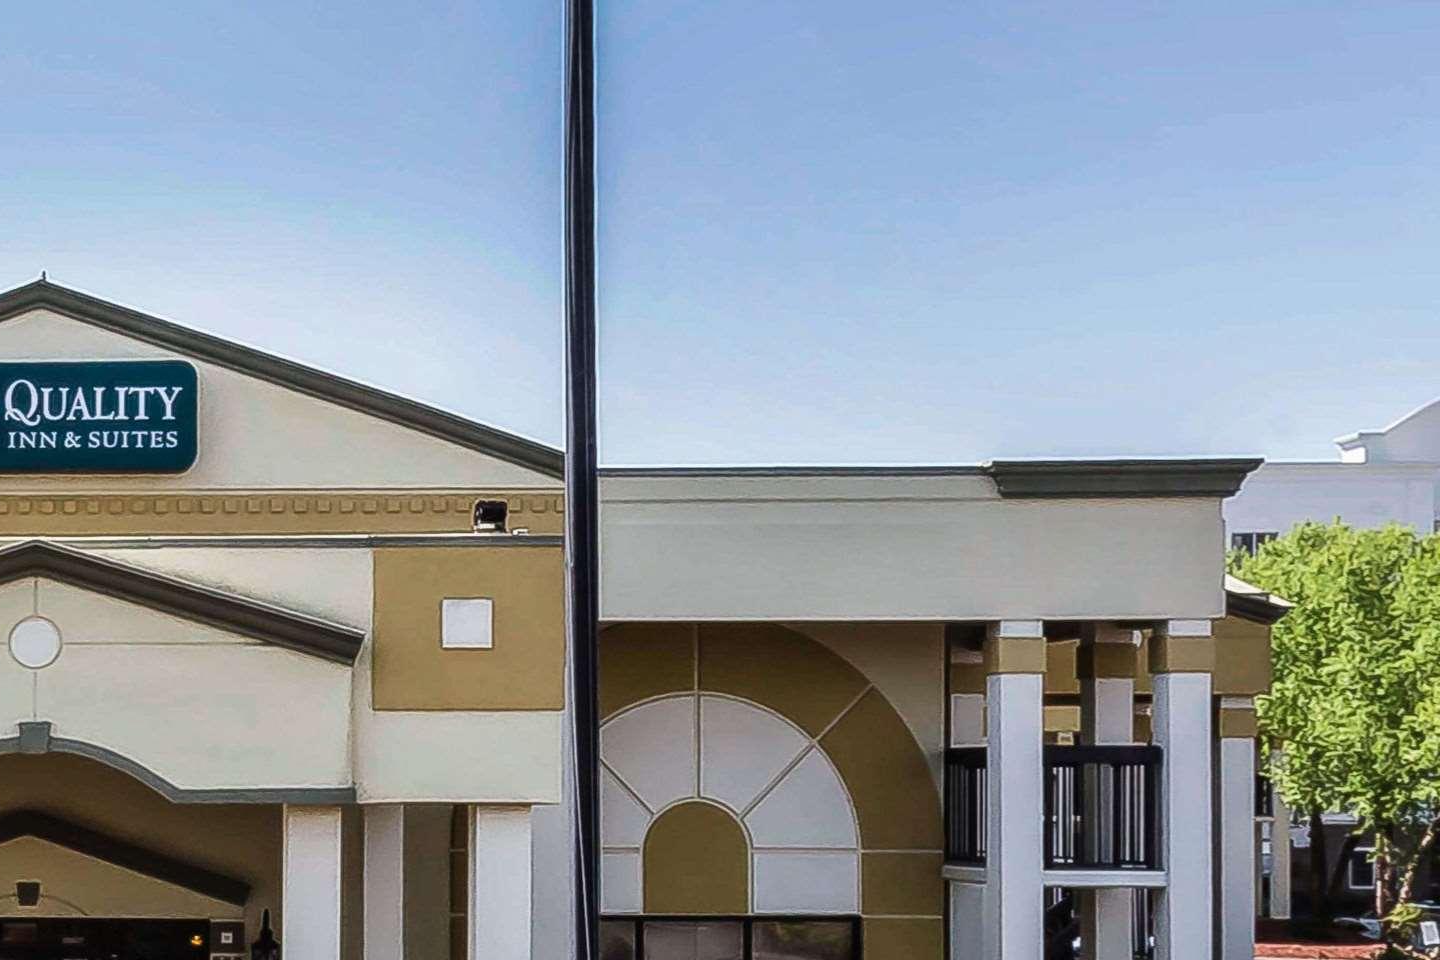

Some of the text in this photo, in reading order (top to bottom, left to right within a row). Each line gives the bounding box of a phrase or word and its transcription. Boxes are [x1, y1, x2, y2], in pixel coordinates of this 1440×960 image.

[4, 379, 183, 427] QUALITY
[7, 430, 179, 449] INN & SUITES
